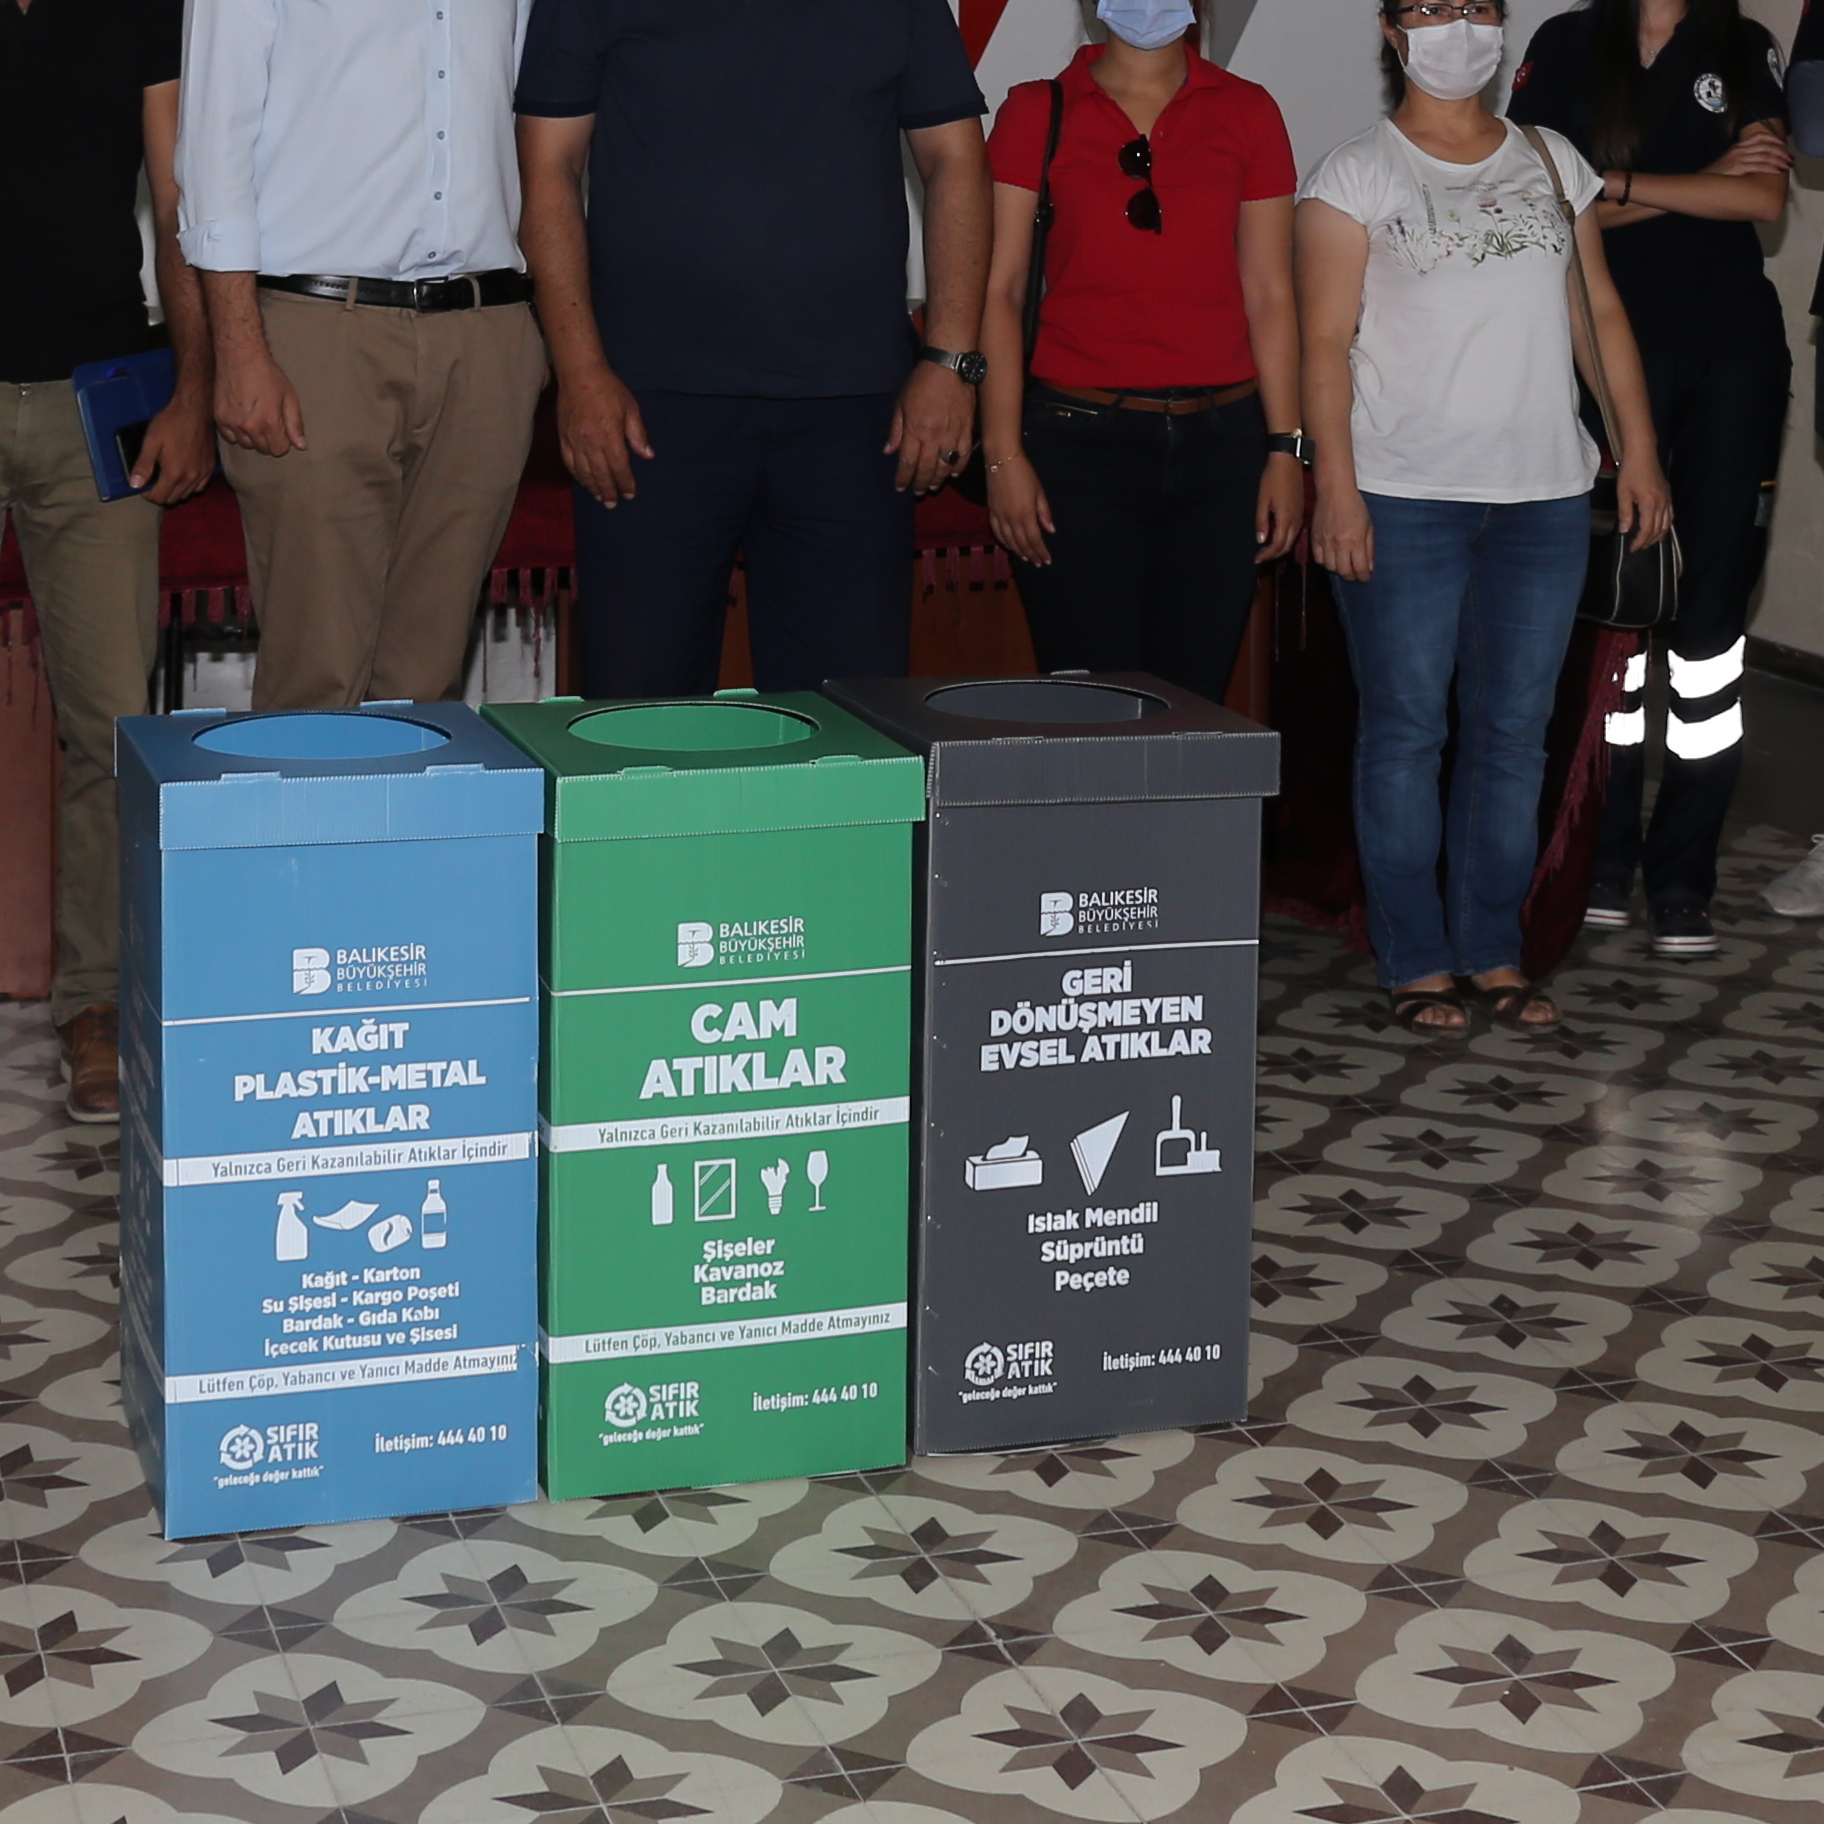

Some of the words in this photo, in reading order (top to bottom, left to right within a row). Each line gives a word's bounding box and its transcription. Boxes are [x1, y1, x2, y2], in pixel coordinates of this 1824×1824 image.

[1078, 886, 1158, 908] BALIKESİR
[719, 915, 805, 938] BALIKESİR
[1078, 904, 1158, 923] BÜYÜKŞEHİR
[1078, 920, 1158, 934] BELEDİYESİ
[336, 942, 427, 964] BALIKESİR
[719, 933, 805, 955] BÜYÜKŞEHİR
[719, 949, 805, 965] BELEDİYESİ
[336, 961, 427, 981] BÜYÜKŞEHİR
[1062, 960, 1132, 996] GERİ
[336, 977, 427, 992] BELEDİYESİ
[690, 997, 797, 1044] CAM
[990, 995, 1203, 1037] DÖNÜŞMEYEN
[311, 1019, 410, 1055] KAĞIT
[980, 1038, 1075, 1072] EVSEL
[1080, 1028, 1212, 1063] ATIKLAR
[233, 1059, 487, 1102] PLASTİK-METAL
[639, 1045, 847, 1100] ATIKLAR
[290, 1103, 431, 1139] ATIKLAR
[597, 1127, 656, 1144] Yalnızca
[660, 1123, 689, 1139] Geri
[693, 1115, 781, 1136] Kazanılabilir
[785, 1113, 832, 1129] Atıklar
[836, 1105, 879, 1127] İçindir
[211, 1161, 272, 1178] Yalnızca
[276, 1156, 307, 1172] Geri
[311, 1149, 404, 1170] Kazanılabilir
[408, 1146, 456, 1163] Atıklar
[461, 1138, 508, 1161] İçindir
[1028, 1209, 1080, 1234] Islak
[1084, 1201, 1158, 1229] Mendil
[702, 1237, 776, 1263] Şişeler
[1041, 1233, 1144, 1263] Süprüntü
[301, 1270, 348, 1289] Kağıt
[363, 1267, 421, 1284] Karton
[693, 1259, 785, 1284] Kavanoz
[1055, 1267, 1130, 1292] Peçete
[262, 1299, 284, 1314] Su
[288, 1292, 337, 1314] Şişesi
[352, 1289, 403, 1306] Kargo
[407, 1281, 460, 1302] Poşeti
[701, 1280, 777, 1306] Bardak
[282, 1313, 343, 1334] Bardak
[358, 1309, 398, 1326] Gıda
[401, 1305, 440, 1323] Kabı
[264, 1336, 319, 1358] İçecek
[322, 1333, 382, 1351] Kutusu
[386, 1331, 406, 1344] ve
[585, 1336, 629, 1354] Lütfen
[632, 1334, 661, 1352] Çöp,
[664, 1331, 716, 1347] Yabancı
[720, 1330, 735, 1341] ve
[738, 1324, 778, 1339] Yanıcı
[781, 1318, 823, 1336] Madde
[827, 1312, 890, 1331] Atmayınız
[1006, 1340, 1054, 1362] SIFIR
[1102, 1351, 1155, 1372] İletişim:
[1158, 1347, 1182, 1365] 444
[1185, 1345, 1201, 1362] 40
[1205, 1344, 1221, 1361] 10
[198, 1376, 245, 1394] Lütfen
[248, 1374, 279, 1393] Çöp,
[282, 1370, 335, 1387] Yabancı
[339, 1368, 355, 1380] ve
[359, 1364, 400, 1380] Yanıcı
[404, 1358, 449, 1375] Madde
[1007, 1358, 1053, 1380] ATIK
[649, 1380, 700, 1403] SIFIR
[753, 1391, 809, 1412] İletişim:
[811, 1387, 838, 1404] 444
[840, 1384, 858, 1401] 40
[861, 1382, 878, 1399] 10
[650, 1399, 700, 1421] ATIK
[266, 1422, 319, 1445] SIFIR
[374, 1432, 434, 1454] İletişim:
[437, 1428, 464, 1446] 444
[467, 1426, 486, 1443] 40
[489, 1424, 507, 1441] 10
[267, 1441, 319, 1464] ATIK
